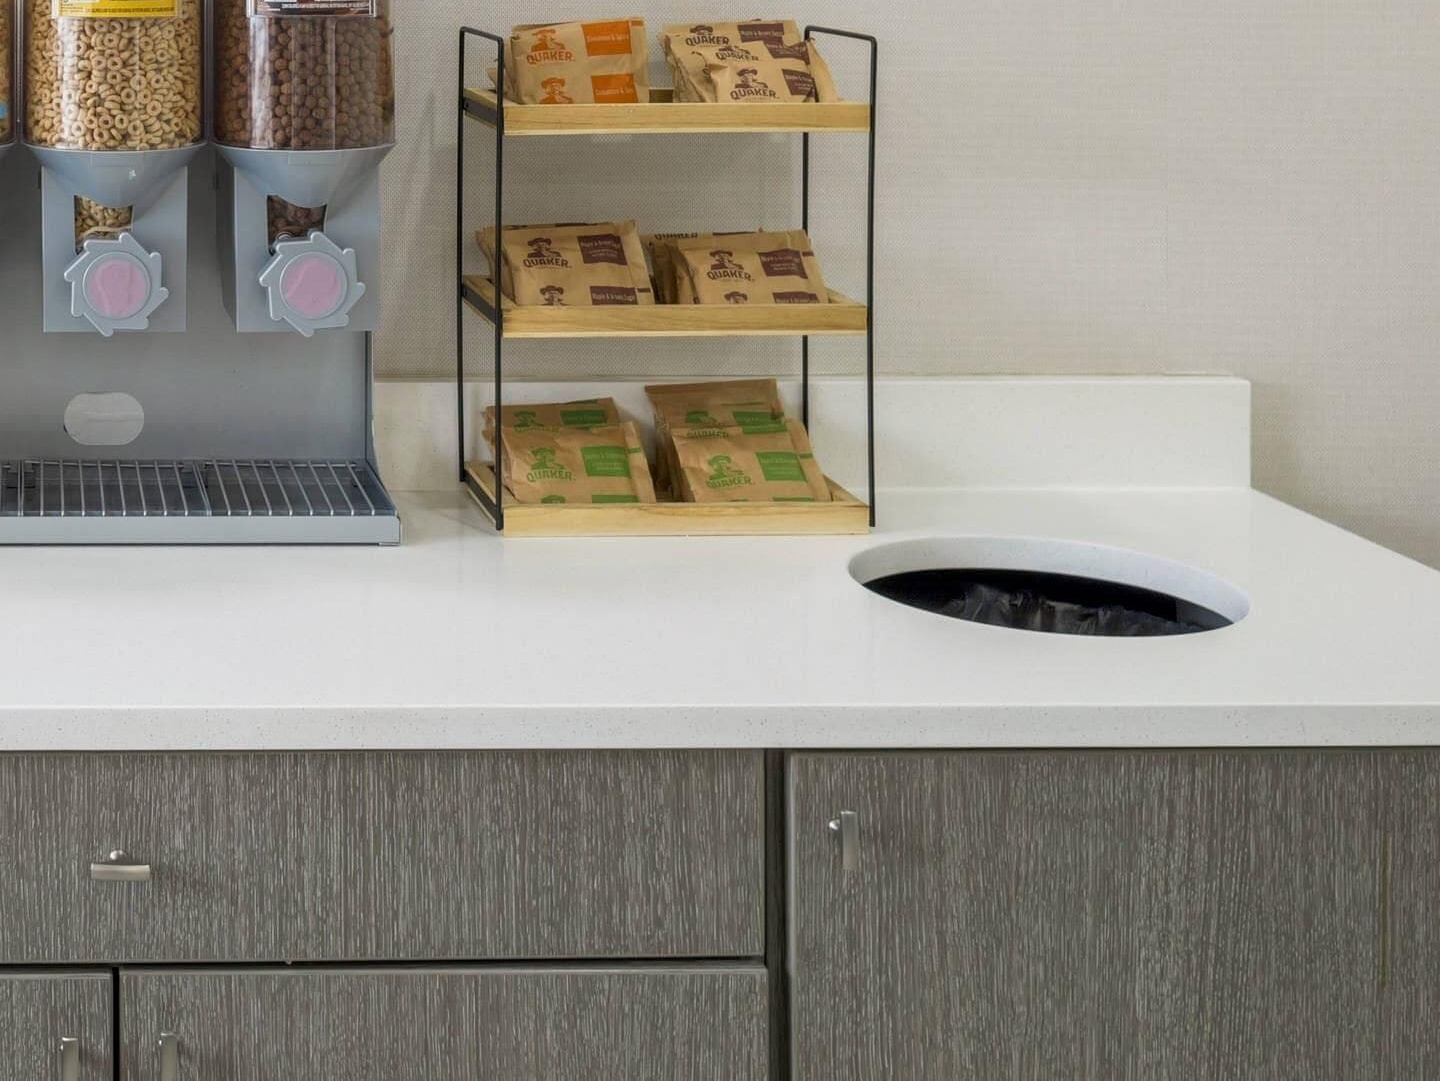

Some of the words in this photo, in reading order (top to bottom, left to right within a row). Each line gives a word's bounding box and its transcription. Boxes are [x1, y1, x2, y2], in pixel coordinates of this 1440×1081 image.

[685, 35, 730, 46] QUAKER
[526, 51, 573, 64] QUAKER
[715, 51, 759, 61] QUAKER
[730, 88, 776, 100] QUAKER
[523, 258, 569, 268] QUAKER
[707, 270, 752, 281] QUAKER
[526, 470, 572, 482] QUAKER
[705, 476, 752, 488] QUAKER
